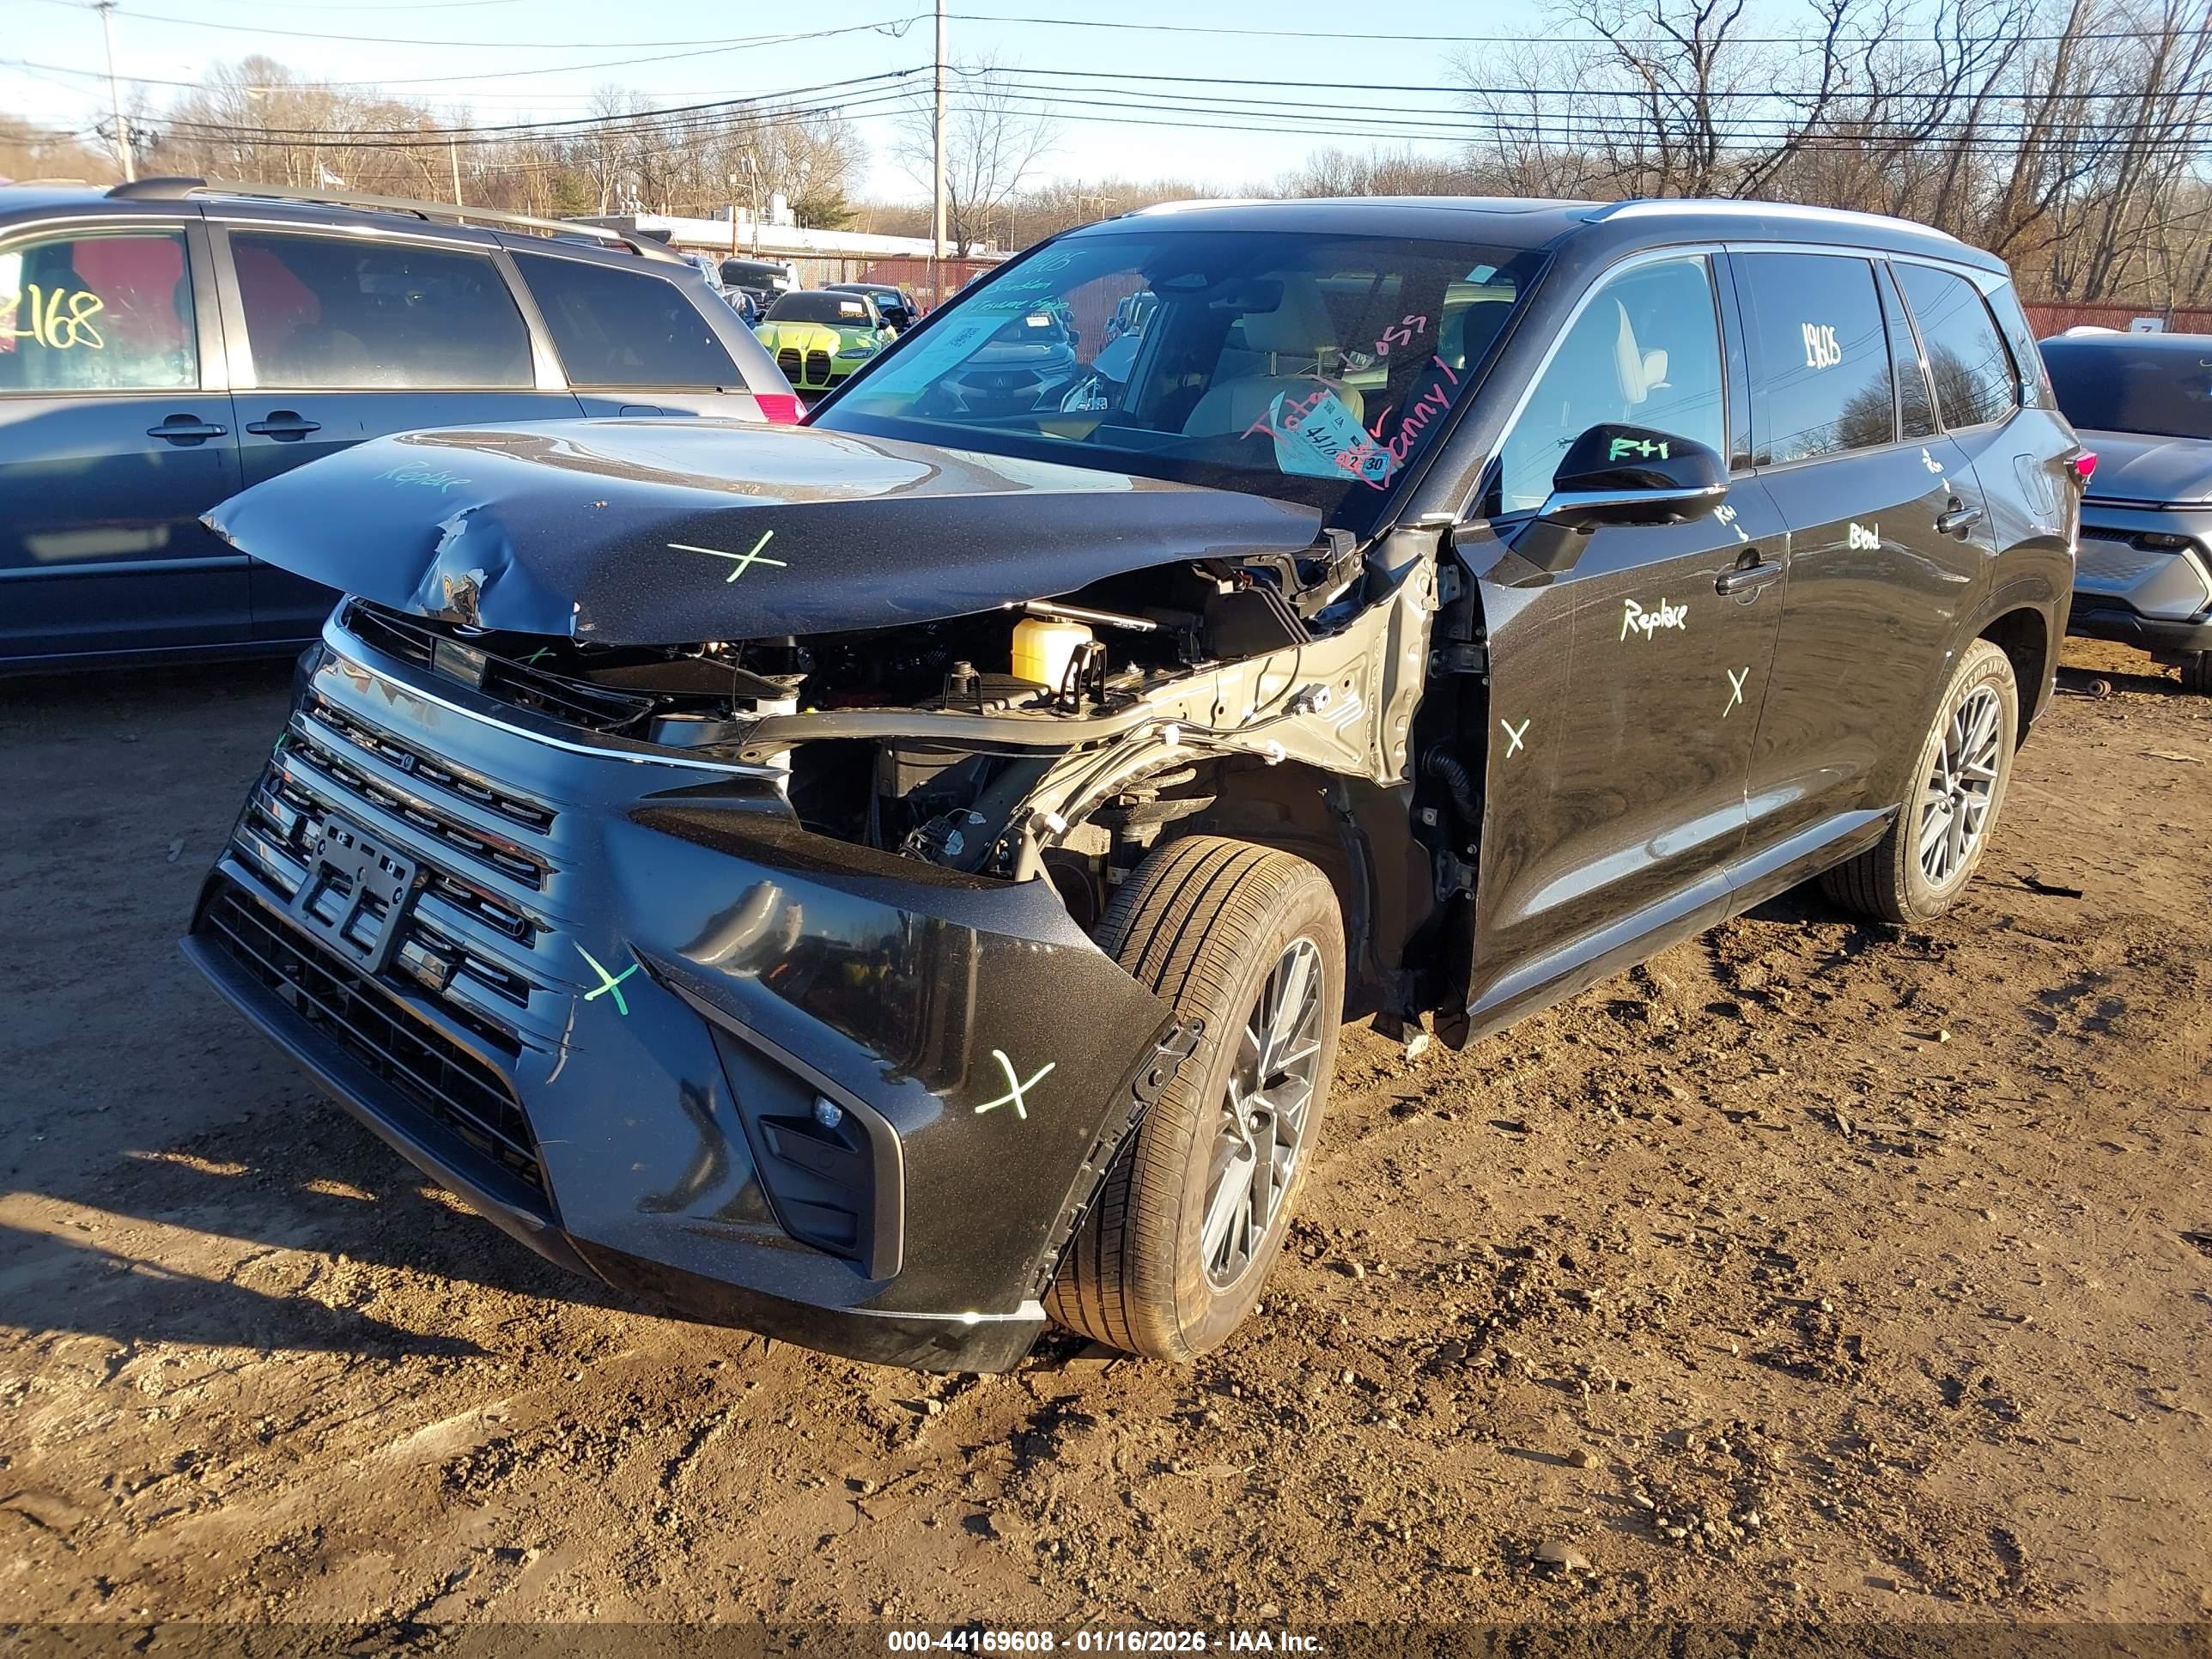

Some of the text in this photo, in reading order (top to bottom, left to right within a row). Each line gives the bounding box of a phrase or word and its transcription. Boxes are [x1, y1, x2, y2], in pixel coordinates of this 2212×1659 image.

[1802, 322, 1842, 370] 19605
[1365, 457, 1383, 471] 30
[1620, 597, 1689, 641] Replace
